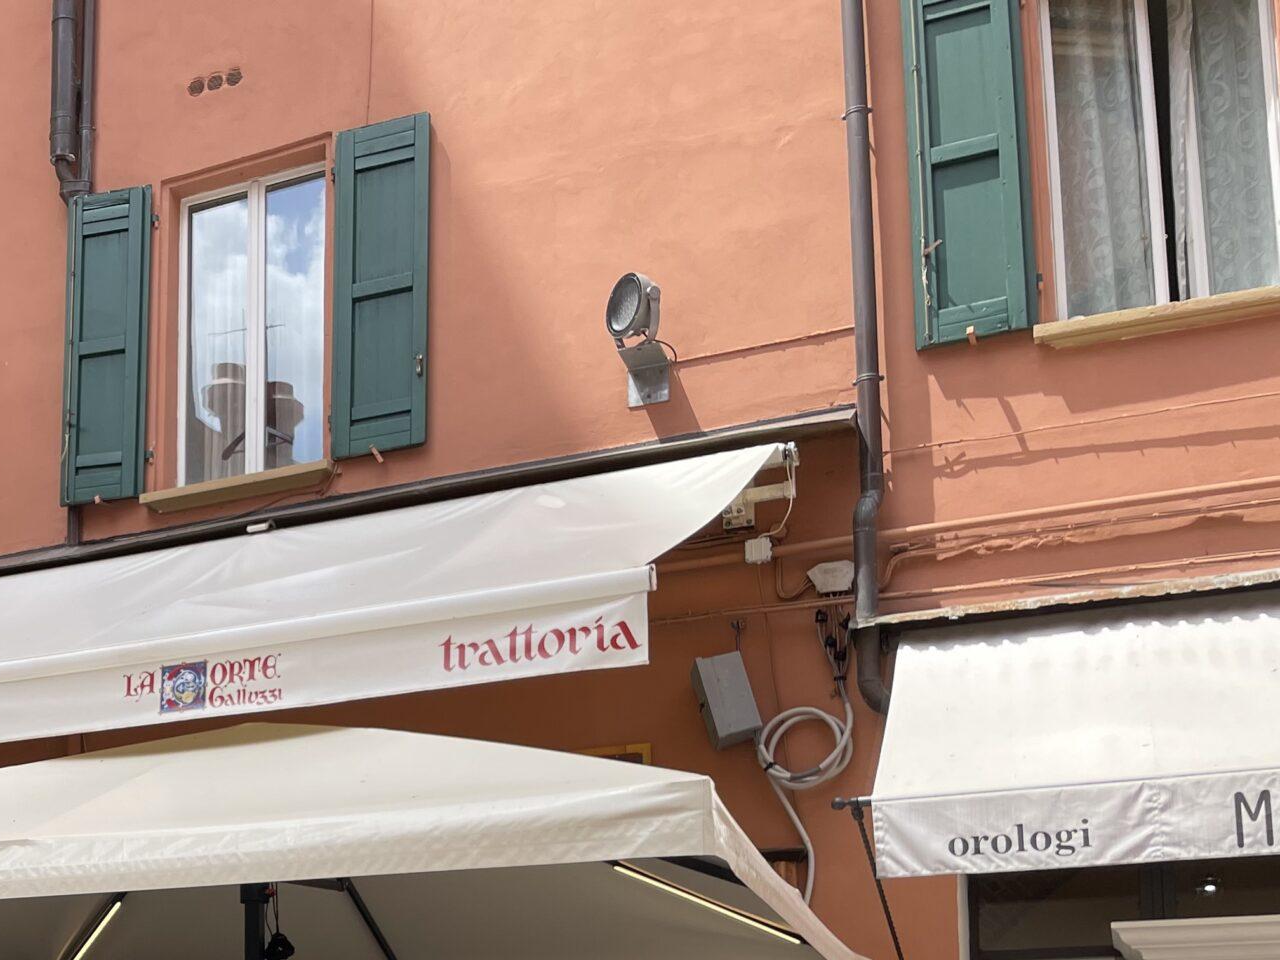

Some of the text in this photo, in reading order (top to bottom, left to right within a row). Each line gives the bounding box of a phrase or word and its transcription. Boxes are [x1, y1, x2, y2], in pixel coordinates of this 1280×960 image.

[438, 616, 643, 673] trattoria
[123, 670, 157, 702] LA
[208, 685, 282, 708] Galluzzi
[947, 818, 1093, 857] orologi
